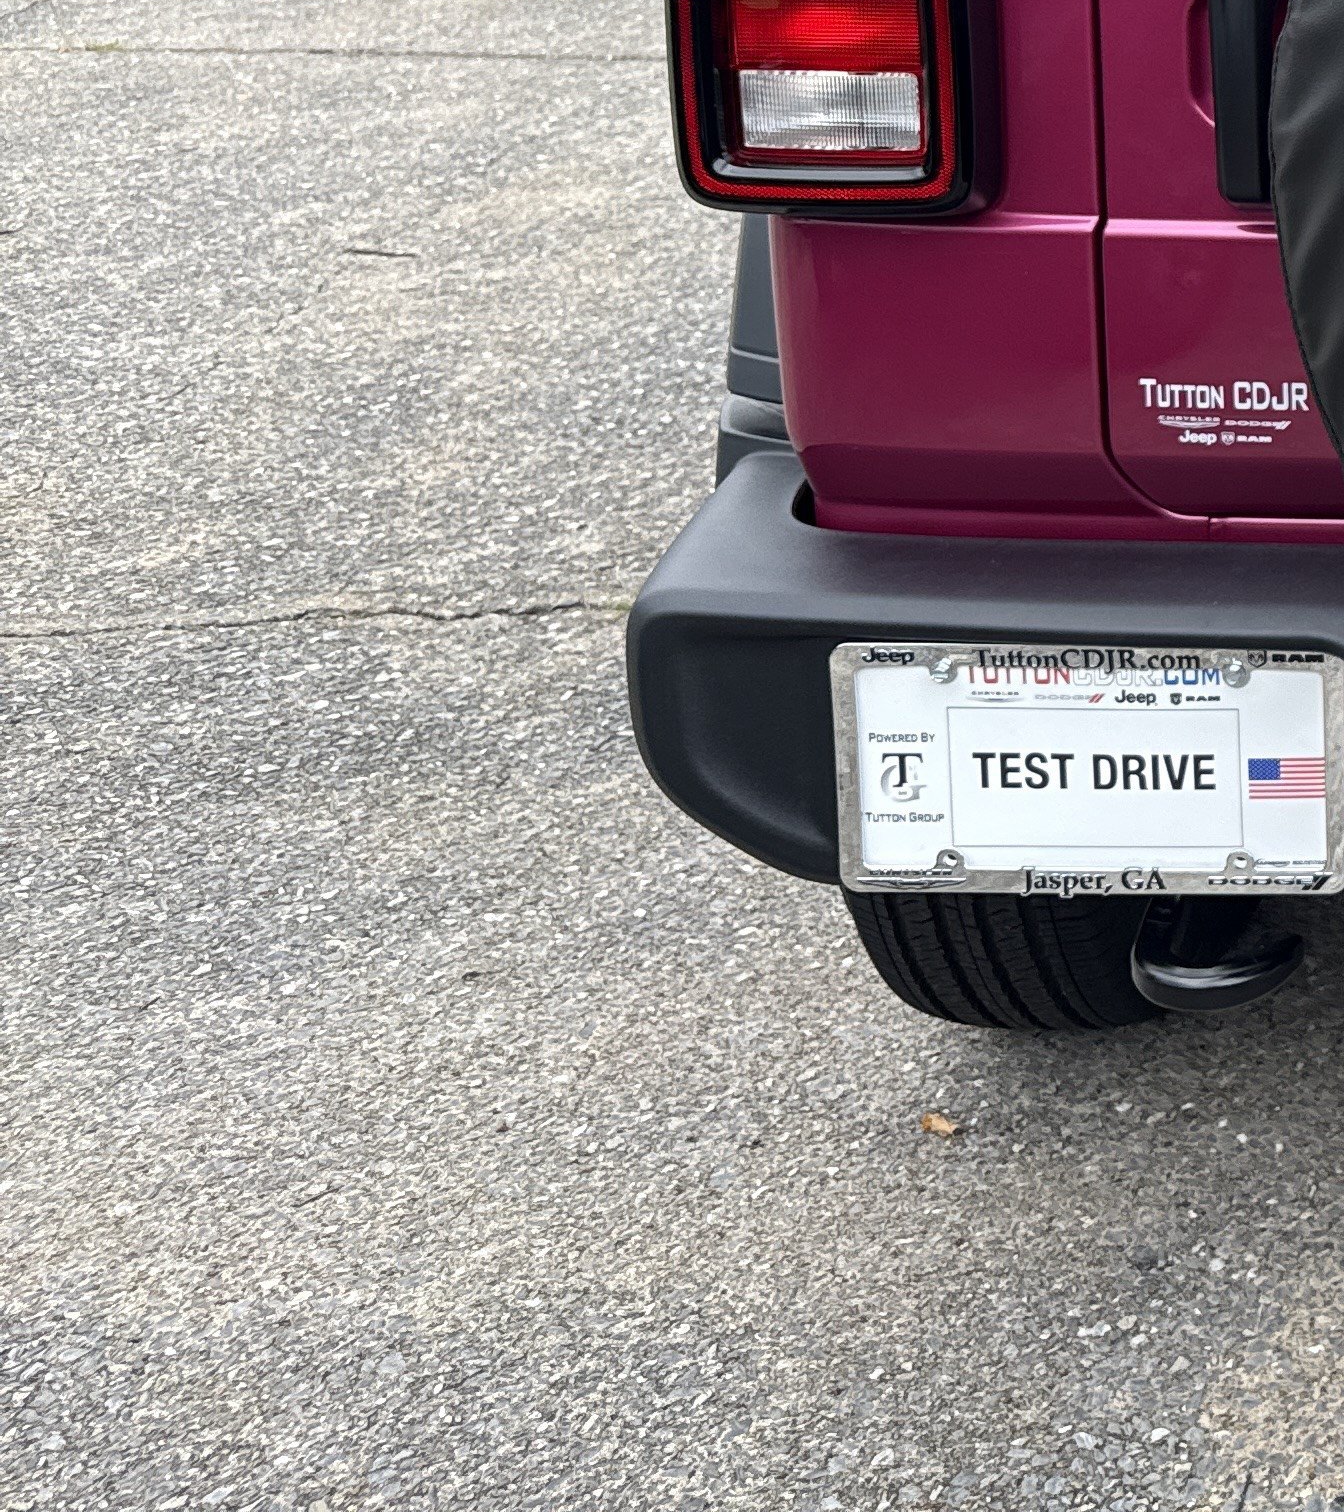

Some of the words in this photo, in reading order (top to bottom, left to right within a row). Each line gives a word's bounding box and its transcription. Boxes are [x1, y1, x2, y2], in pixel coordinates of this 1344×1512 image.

[1138, 377, 1225, 410] TUTTON
[1233, 380, 1310, 412] CDJR
[1179, 429, 1217, 446] Jeep
[1236, 435, 1273, 443] RAM
[861, 647, 915, 665] Jeep
[972, 648, 1201, 674] TuttonCDJR.com
[1271, 653, 1325, 664] RAM
[1114, 689, 1157, 706] Jeep
[972, 751, 1075, 790] TEST
[1092, 753, 1216, 791] DRIVE
[1021, 866, 1114, 897] Jasper,
[1121, 867, 1167, 890] GA
